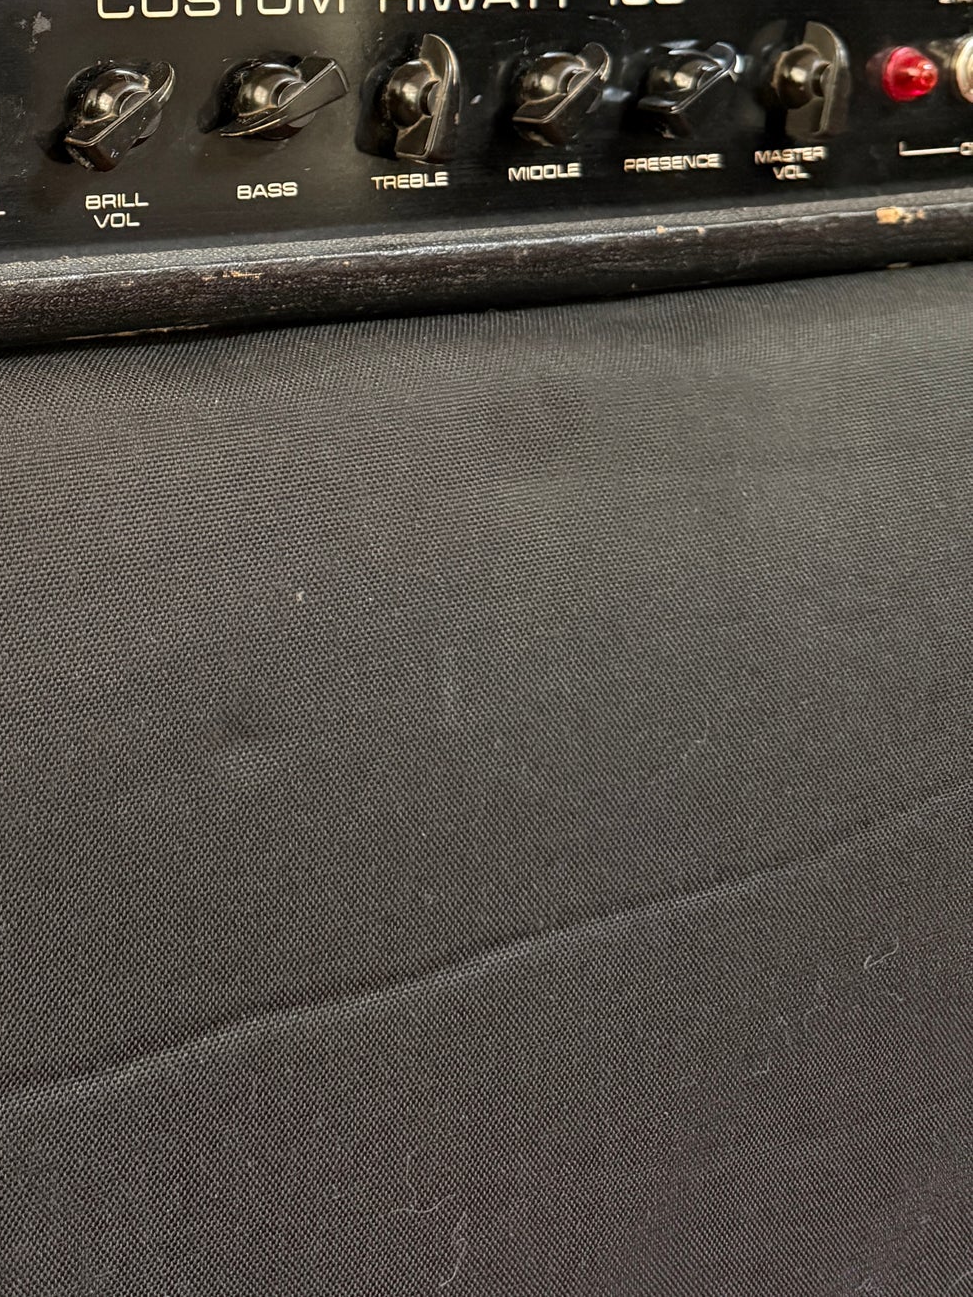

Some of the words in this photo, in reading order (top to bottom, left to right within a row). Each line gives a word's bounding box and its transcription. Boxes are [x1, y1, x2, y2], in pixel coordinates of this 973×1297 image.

[623, 153, 723, 172] PRESENCE
[754, 146, 827, 166] MASTER
[370, 171, 449, 190] TREBLE
[508, 162, 582, 181] MIDDLE
[772, 165, 809, 180] VOL
[236, 181, 298, 200] BASS
[85, 192, 149, 210] BRILL
[93, 212, 140, 229] VOL
